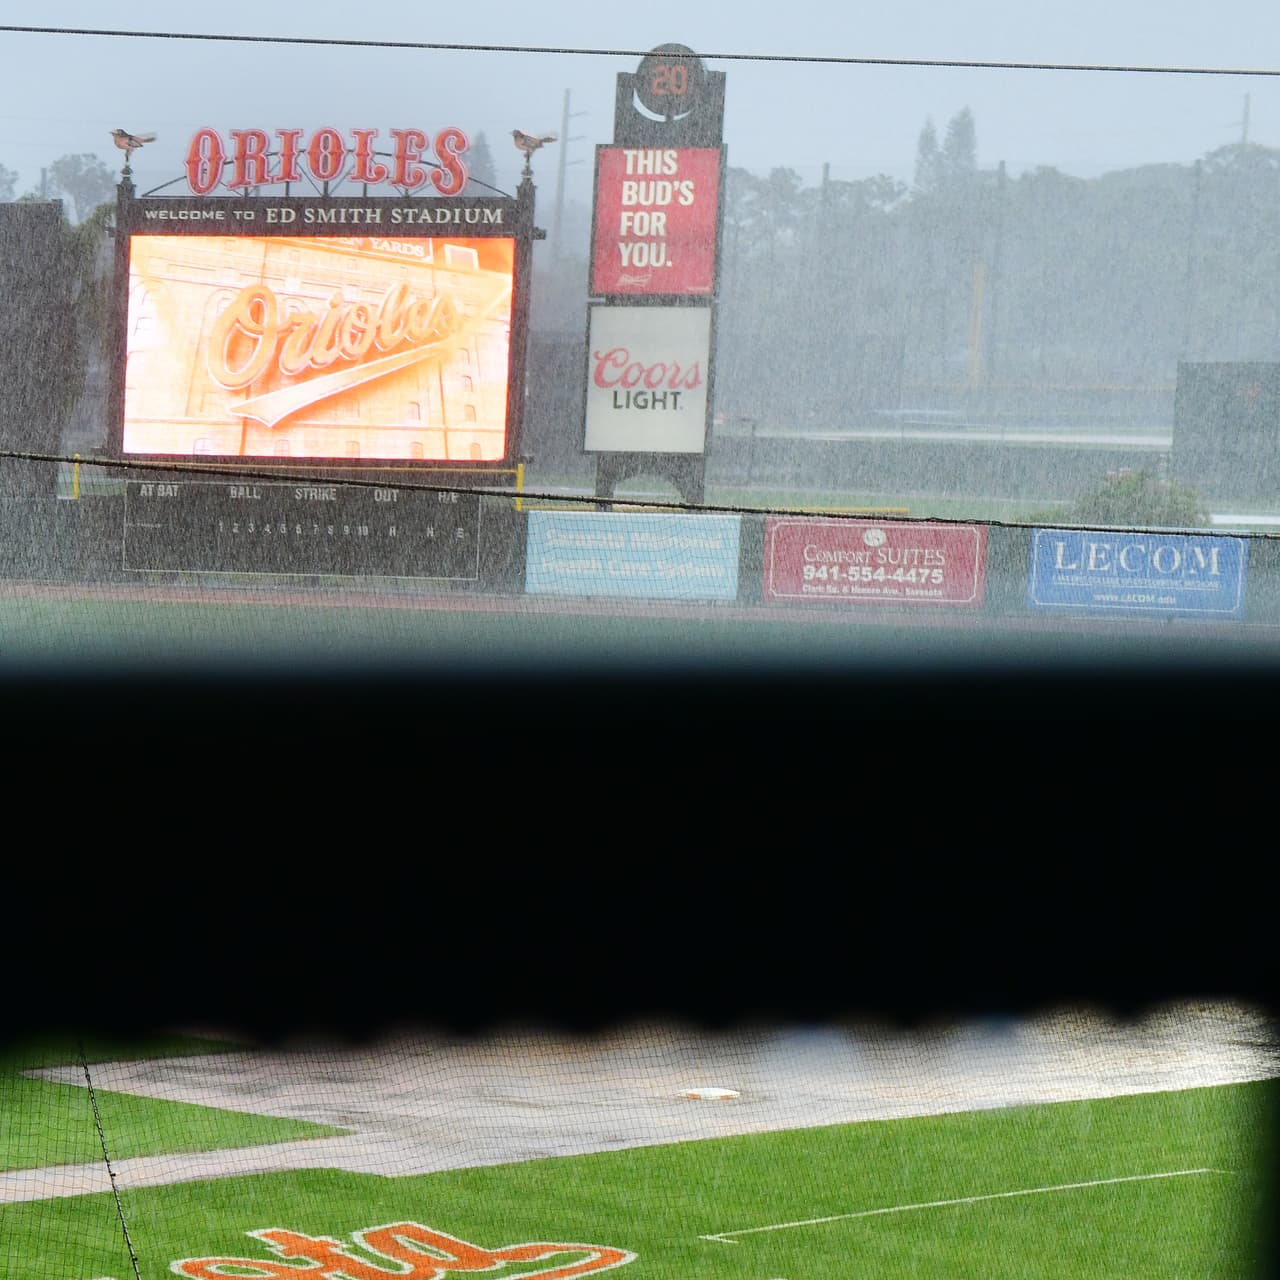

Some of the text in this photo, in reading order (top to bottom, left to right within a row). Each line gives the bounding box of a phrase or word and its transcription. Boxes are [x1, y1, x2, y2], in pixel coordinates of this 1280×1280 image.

[652, 64, 688, 95] 20
[184, 126, 471, 197] ORIOLES
[623, 150, 678, 175] THIS
[621, 181, 695, 206] BUD'S
[145, 208, 504, 225] WELCOME TO ED SMITH STADIUM
[620, 211, 667, 237] FOR
[368, 236, 425, 257] YARDS
[618, 242, 673, 268] YOU.
[206, 282, 466, 391] Orioles
[593, 347, 702, 390] Coors
[612, 390, 683, 411] LIGHT
[139, 484, 180, 498] AT BAT
[229, 485, 261, 499] BALL
[294, 487, 337, 501] STRIKE
[374, 489, 400, 502] OUT
[804, 545, 946, 566] COMFORT SUITES
[1055, 541, 1221, 576] LECOM
[803, 565, 943, 583] 941-554-4475
